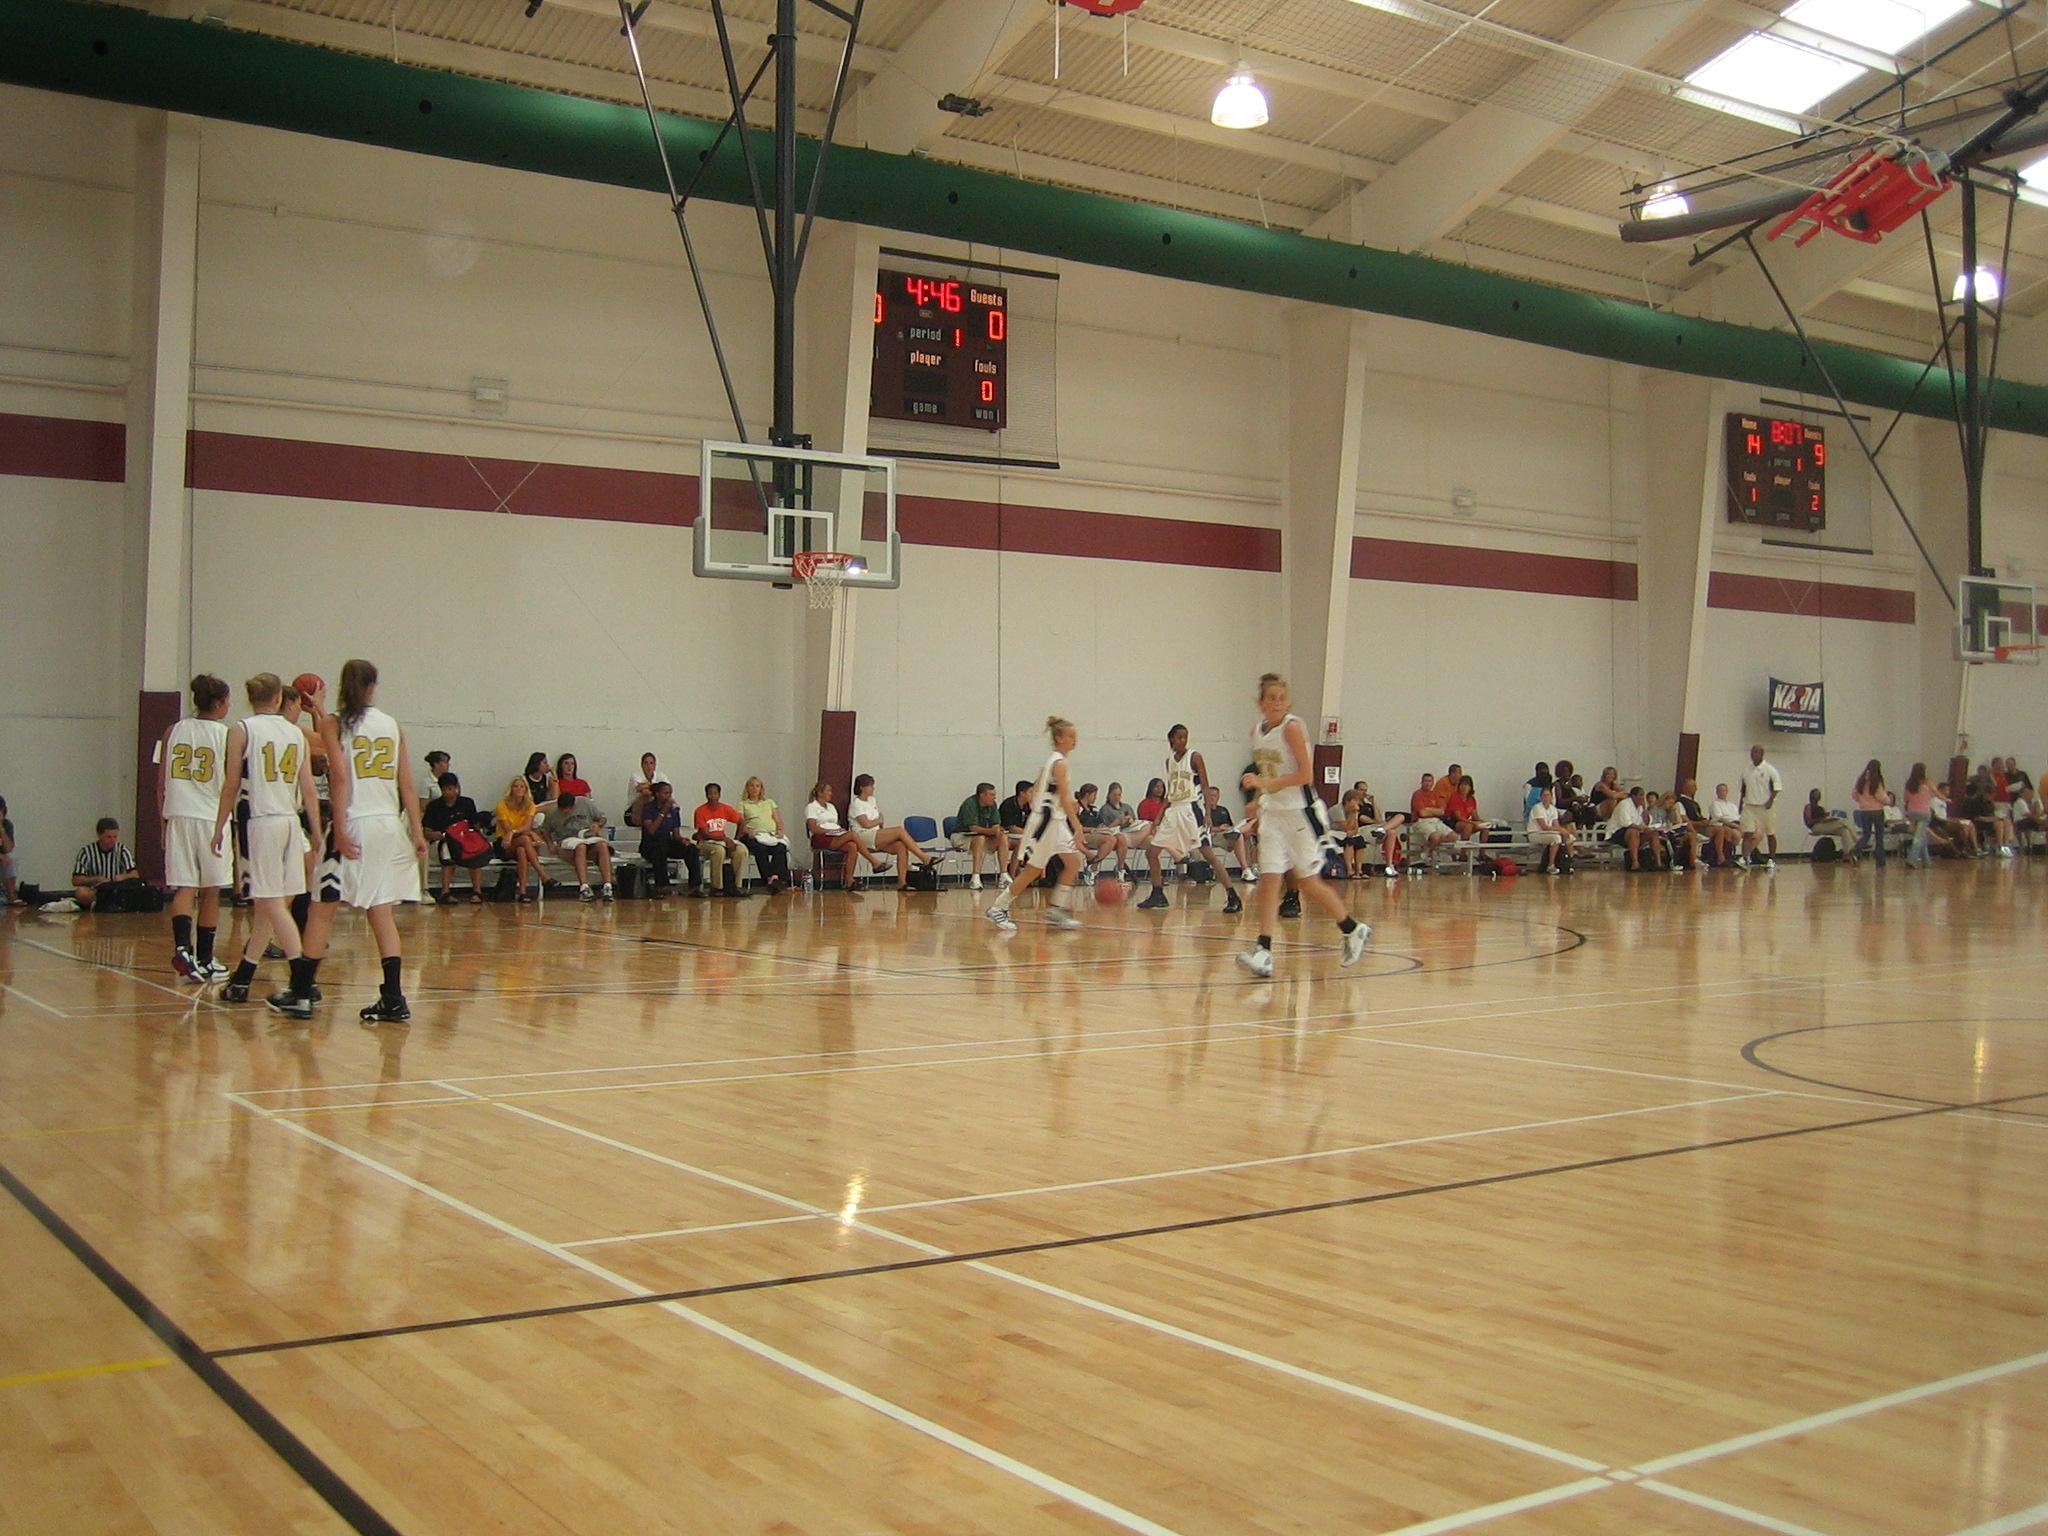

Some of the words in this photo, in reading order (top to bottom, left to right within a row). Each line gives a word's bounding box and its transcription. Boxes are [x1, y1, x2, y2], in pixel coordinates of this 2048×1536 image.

[907, 277, 960, 312] 4:46
[970, 289, 1003, 307] Guests
[989, 311, 1004, 340] 0
[910, 327, 941, 341] period
[955, 328, 961, 347] 1
[910, 350, 942, 367] player
[975, 360, 997, 374] fouls
[981, 380, 993, 401] 0
[913, 401, 938, 415] game
[975, 408, 994, 420] won
[1747, 434, 1761, 455] 14
[1814, 443, 1824, 465] 9
[1811, 494, 1819, 511] 2
[171, 743, 215, 782] 23
[261, 741, 298, 784] 14
[352, 736, 395, 780] 22
